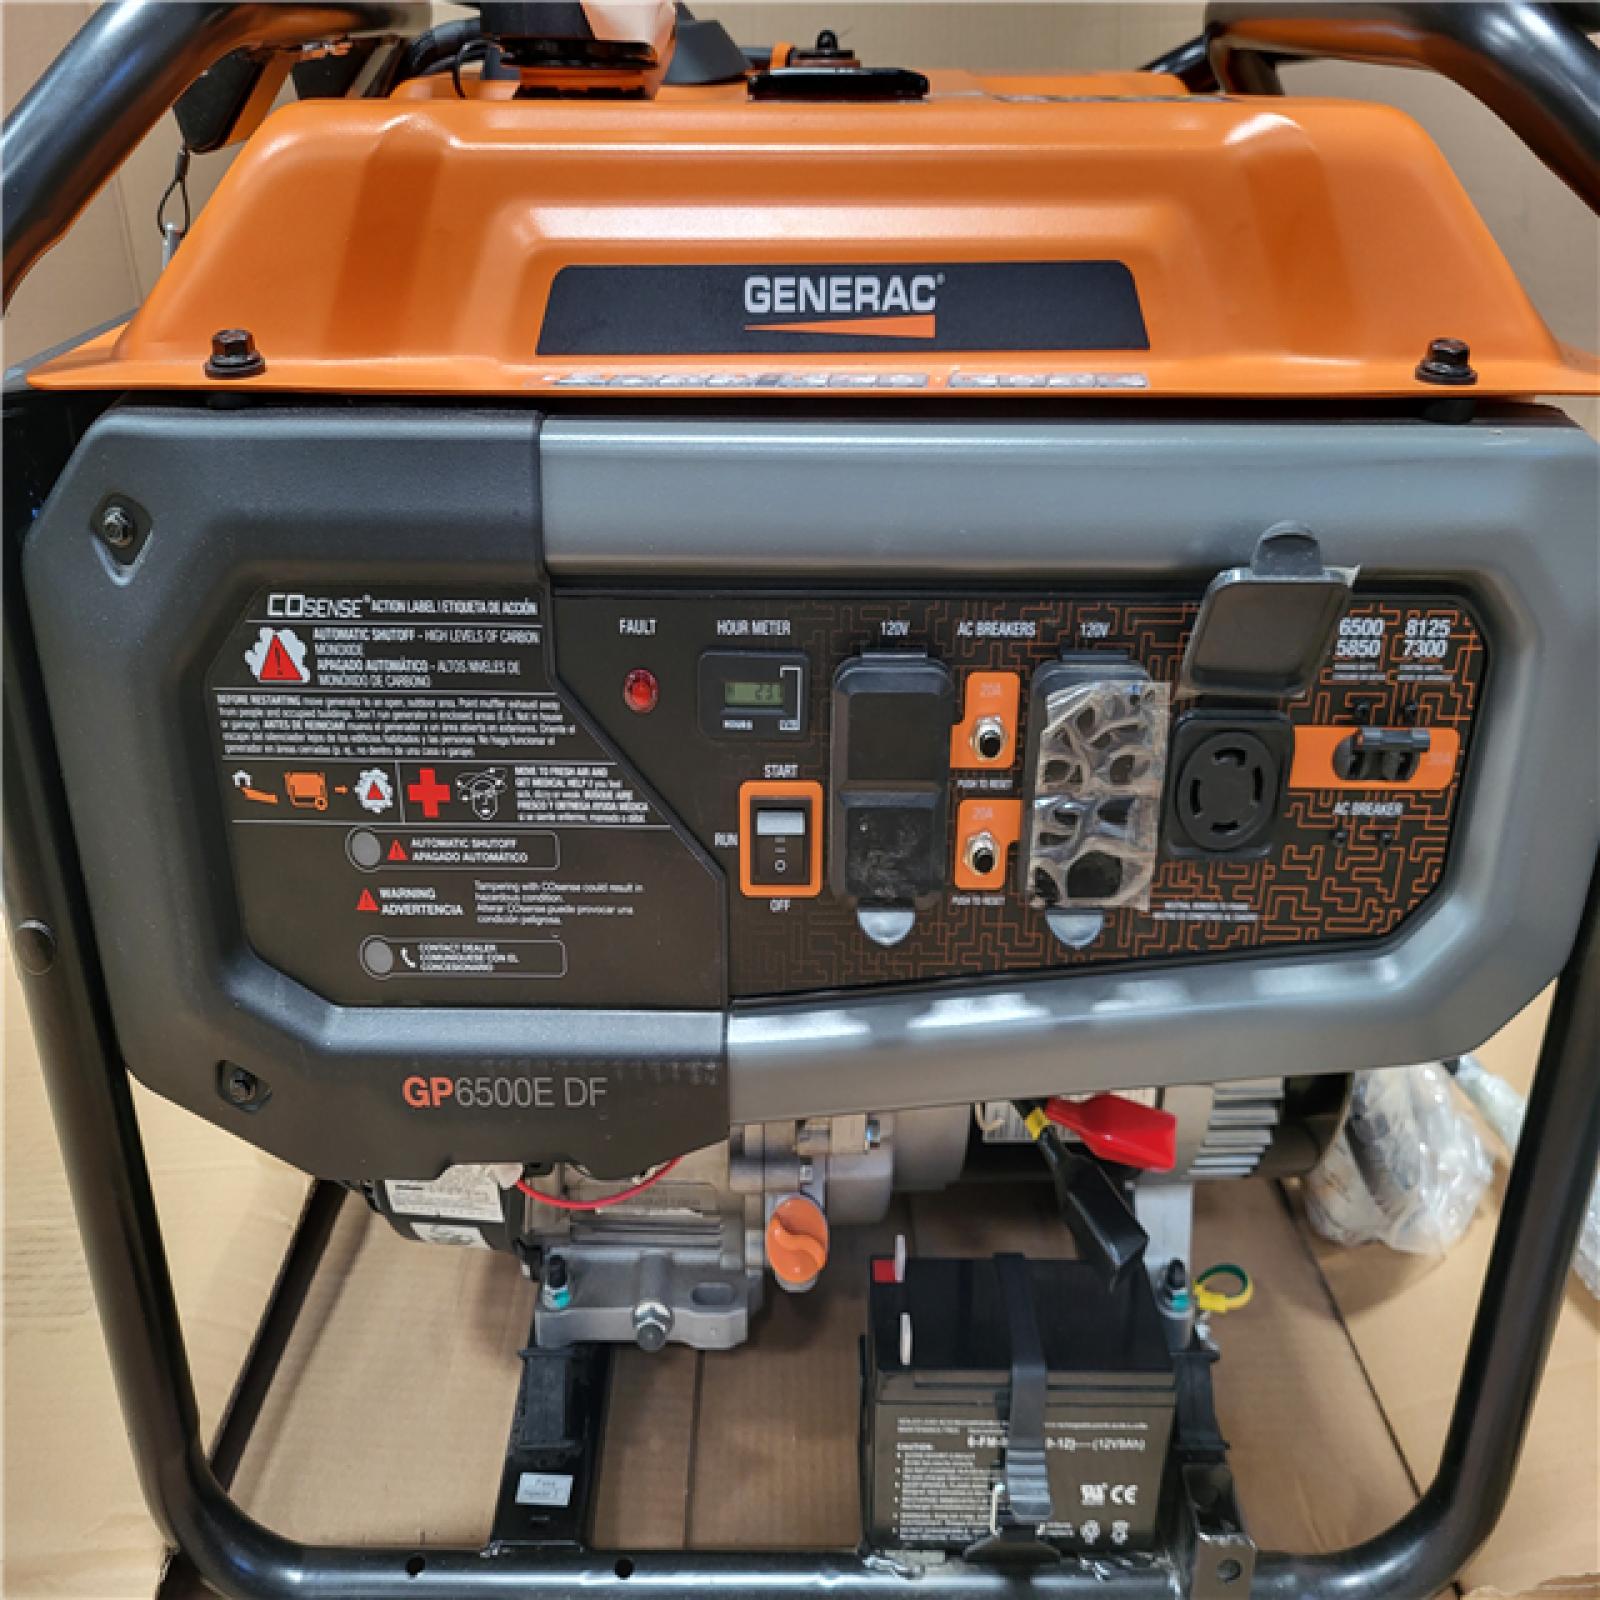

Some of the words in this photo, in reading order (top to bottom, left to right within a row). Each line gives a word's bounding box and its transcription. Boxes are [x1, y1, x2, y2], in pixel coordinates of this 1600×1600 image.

[744, 274, 936, 313] GENERAC
[407, 599, 436, 614] LABEL
[619, 618, 656, 635] FAULT
[716, 619, 748, 635] HOUR
[752, 619, 791, 635] METER
[880, 620, 910, 636] 120V
[957, 621, 974, 636] AC
[976, 621, 1035, 638] BREAKERS
[1080, 622, 1110, 639] 120V
[1339, 618, 1385, 637] 6500
[1404, 618, 1450, 638] 8125
[313, 627, 370, 641] AUTOMATIC
[372, 627, 415, 642] SHUTOFF
[425, 629, 448, 642] HIGH
[450, 629, 483, 643] LEVELS
[485, 630, 498, 643] OF
[500, 630, 540, 644] CARBON
[1335, 639, 1381, 657] 5850
[1403, 640, 1448, 658] 7300
[764, 764, 798, 778] START
[1333, 803, 1350, 815] AC
[1352, 803, 1403, 816] BREAKER
[411, 838, 468, 848] AUTOMATIC
[472, 838, 517, 849] SHUTOFF
[715, 832, 738, 847] RUN
[412, 851, 460, 862] APAGADO
[379, 888, 436, 900] WARNING
[381, 904, 464, 916] ADVERTENCIA
[770, 899, 790, 912] OFF
[402, 1075, 553, 1109] GP6500E
[564, 1076, 607, 1107] DF
